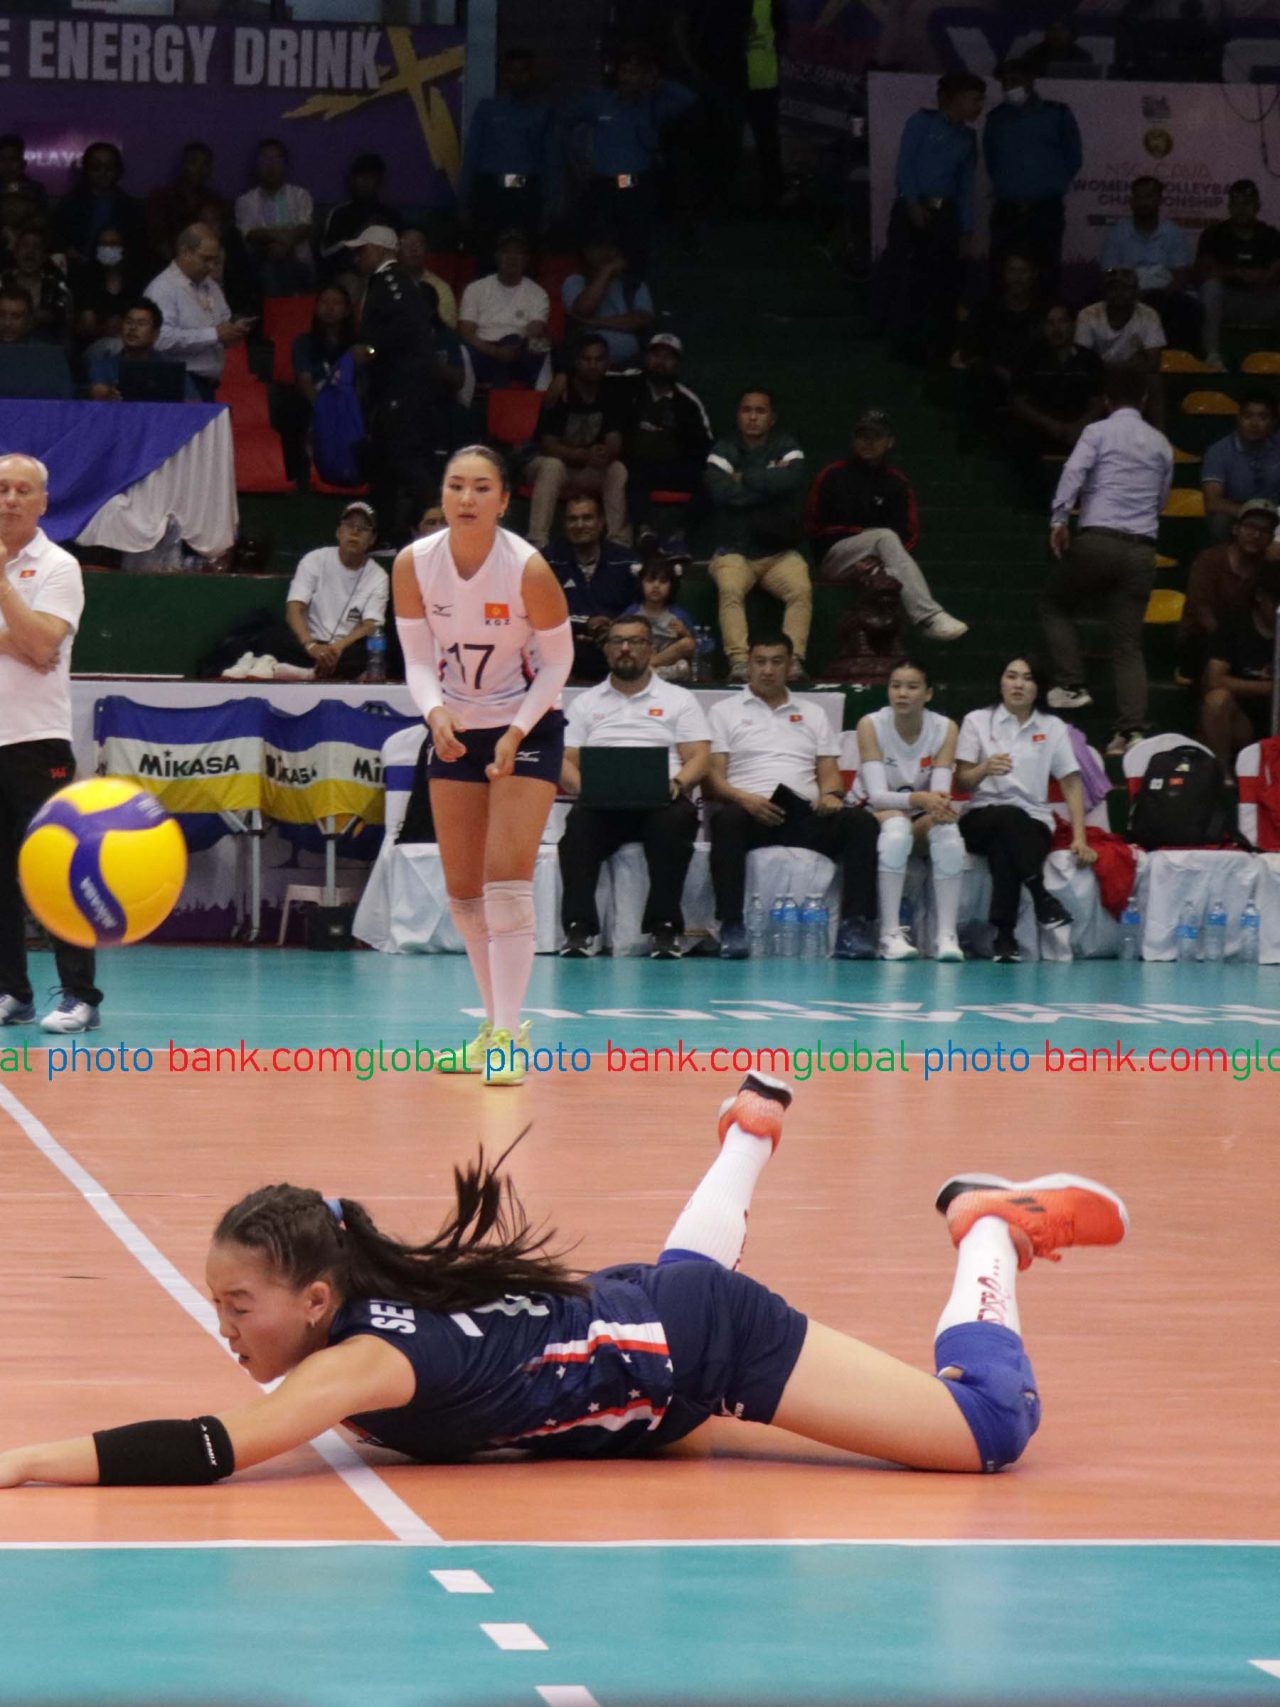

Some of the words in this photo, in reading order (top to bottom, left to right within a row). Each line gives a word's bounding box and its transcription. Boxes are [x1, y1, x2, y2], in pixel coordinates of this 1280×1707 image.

[28, 20, 218, 85] ENERGY
[232, 27, 382, 90] DRINK
[447, 642, 495, 690] 17
[369, 1300, 417, 1334] SE
